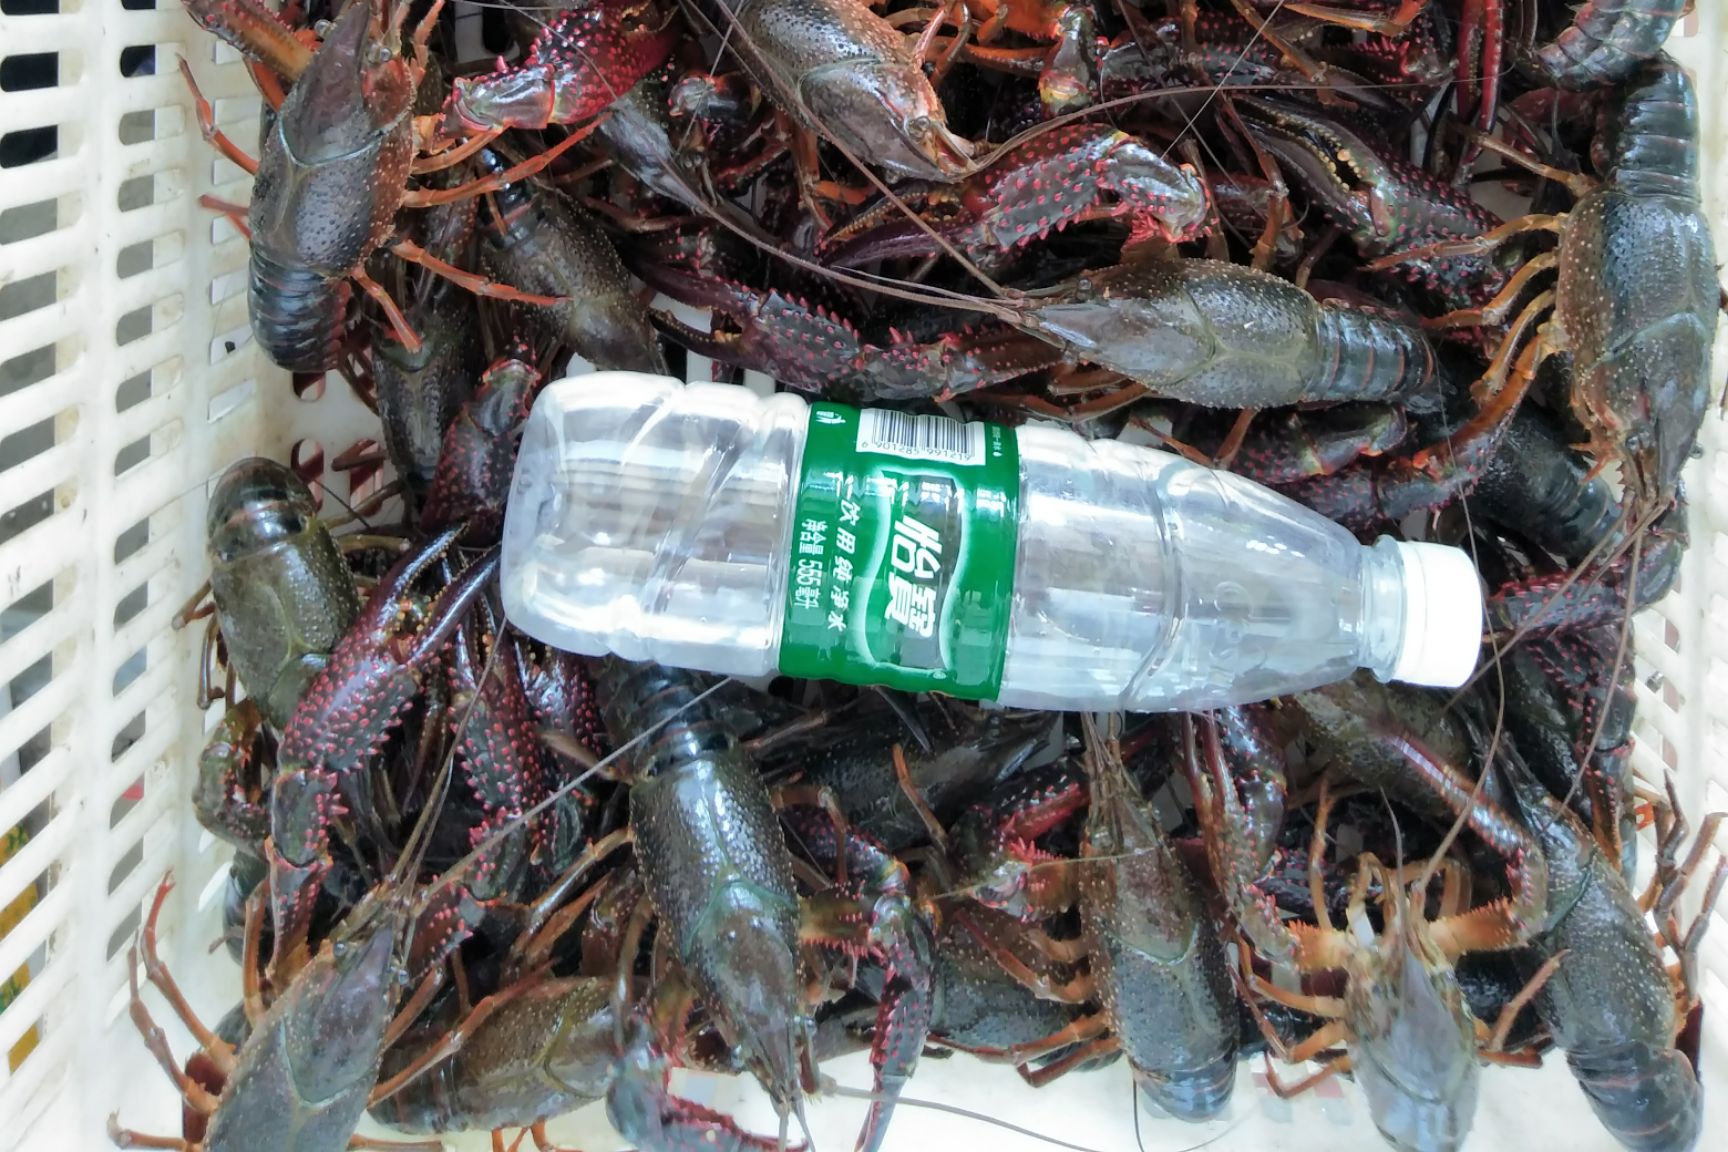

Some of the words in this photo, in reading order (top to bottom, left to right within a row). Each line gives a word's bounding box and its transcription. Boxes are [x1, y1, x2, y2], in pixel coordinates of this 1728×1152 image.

[874, 439, 920, 456] 901285
[926, 447, 972, 462] 991219
[800, 519, 828, 554] 净含量
[794, 559, 823, 610] 555毫升
[827, 496, 861, 633] 饮用纯净水
[885, 515, 943, 638] 怡寶
